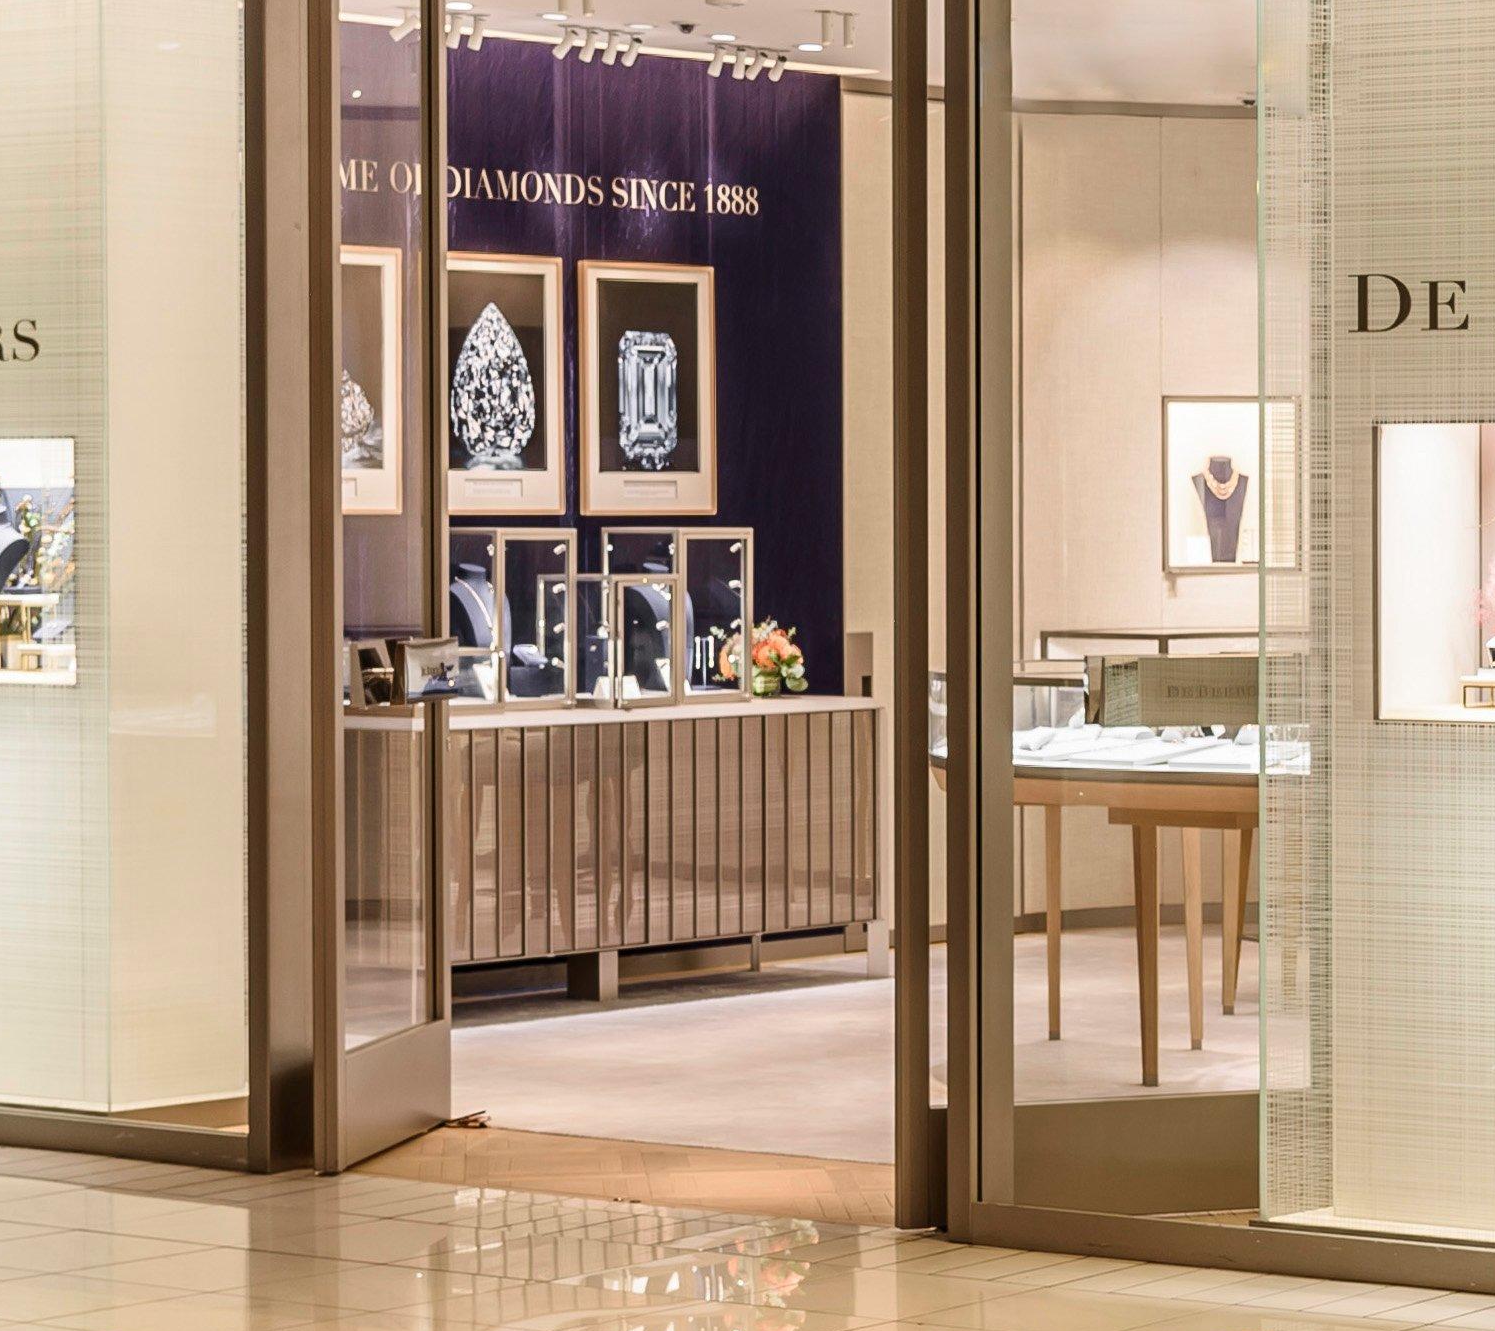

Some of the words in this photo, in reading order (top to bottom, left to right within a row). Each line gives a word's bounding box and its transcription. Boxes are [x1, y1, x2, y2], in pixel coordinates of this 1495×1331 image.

[447, 165, 604, 207] DIAMONDS
[611, 177, 696, 212] SINCE
[703, 183, 759, 217] 1888
[1347, 273, 1470, 333] DE
